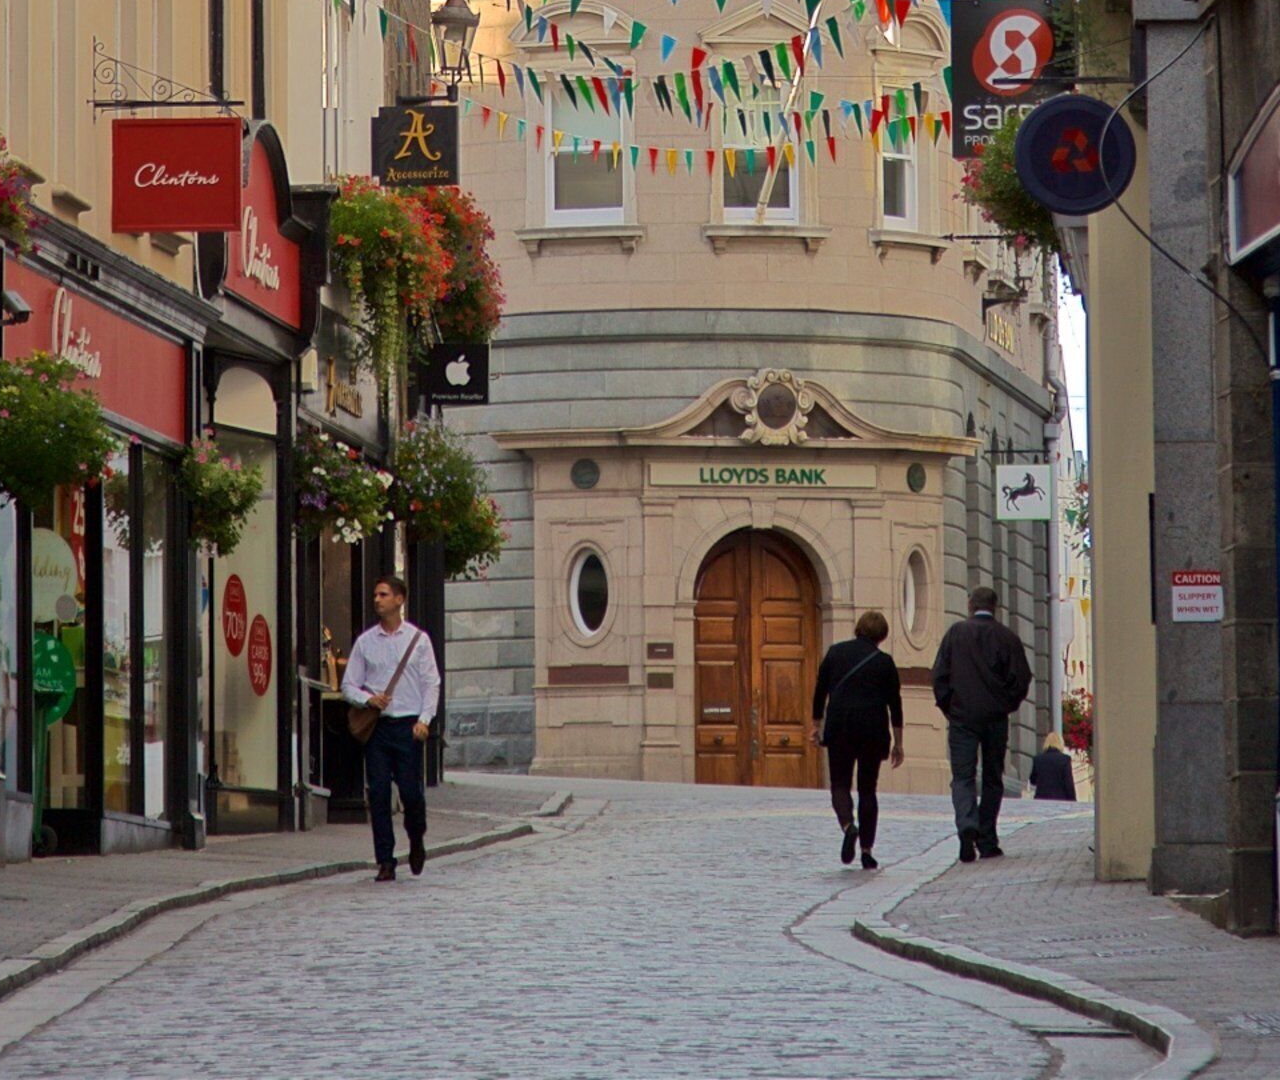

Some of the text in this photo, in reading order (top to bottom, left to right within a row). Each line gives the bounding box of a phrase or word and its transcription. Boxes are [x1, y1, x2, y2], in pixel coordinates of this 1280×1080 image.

[134, 163, 220, 188] Clintons
[387, 167, 449, 182] Accessorize
[700, 467, 827, 485] LLOYDS BANK
[1175, 573, 1221, 584] CAUTION
[1178, 592, 1217, 601] SLIPPERY
[1176, 605, 1219, 613] WHEN WET
